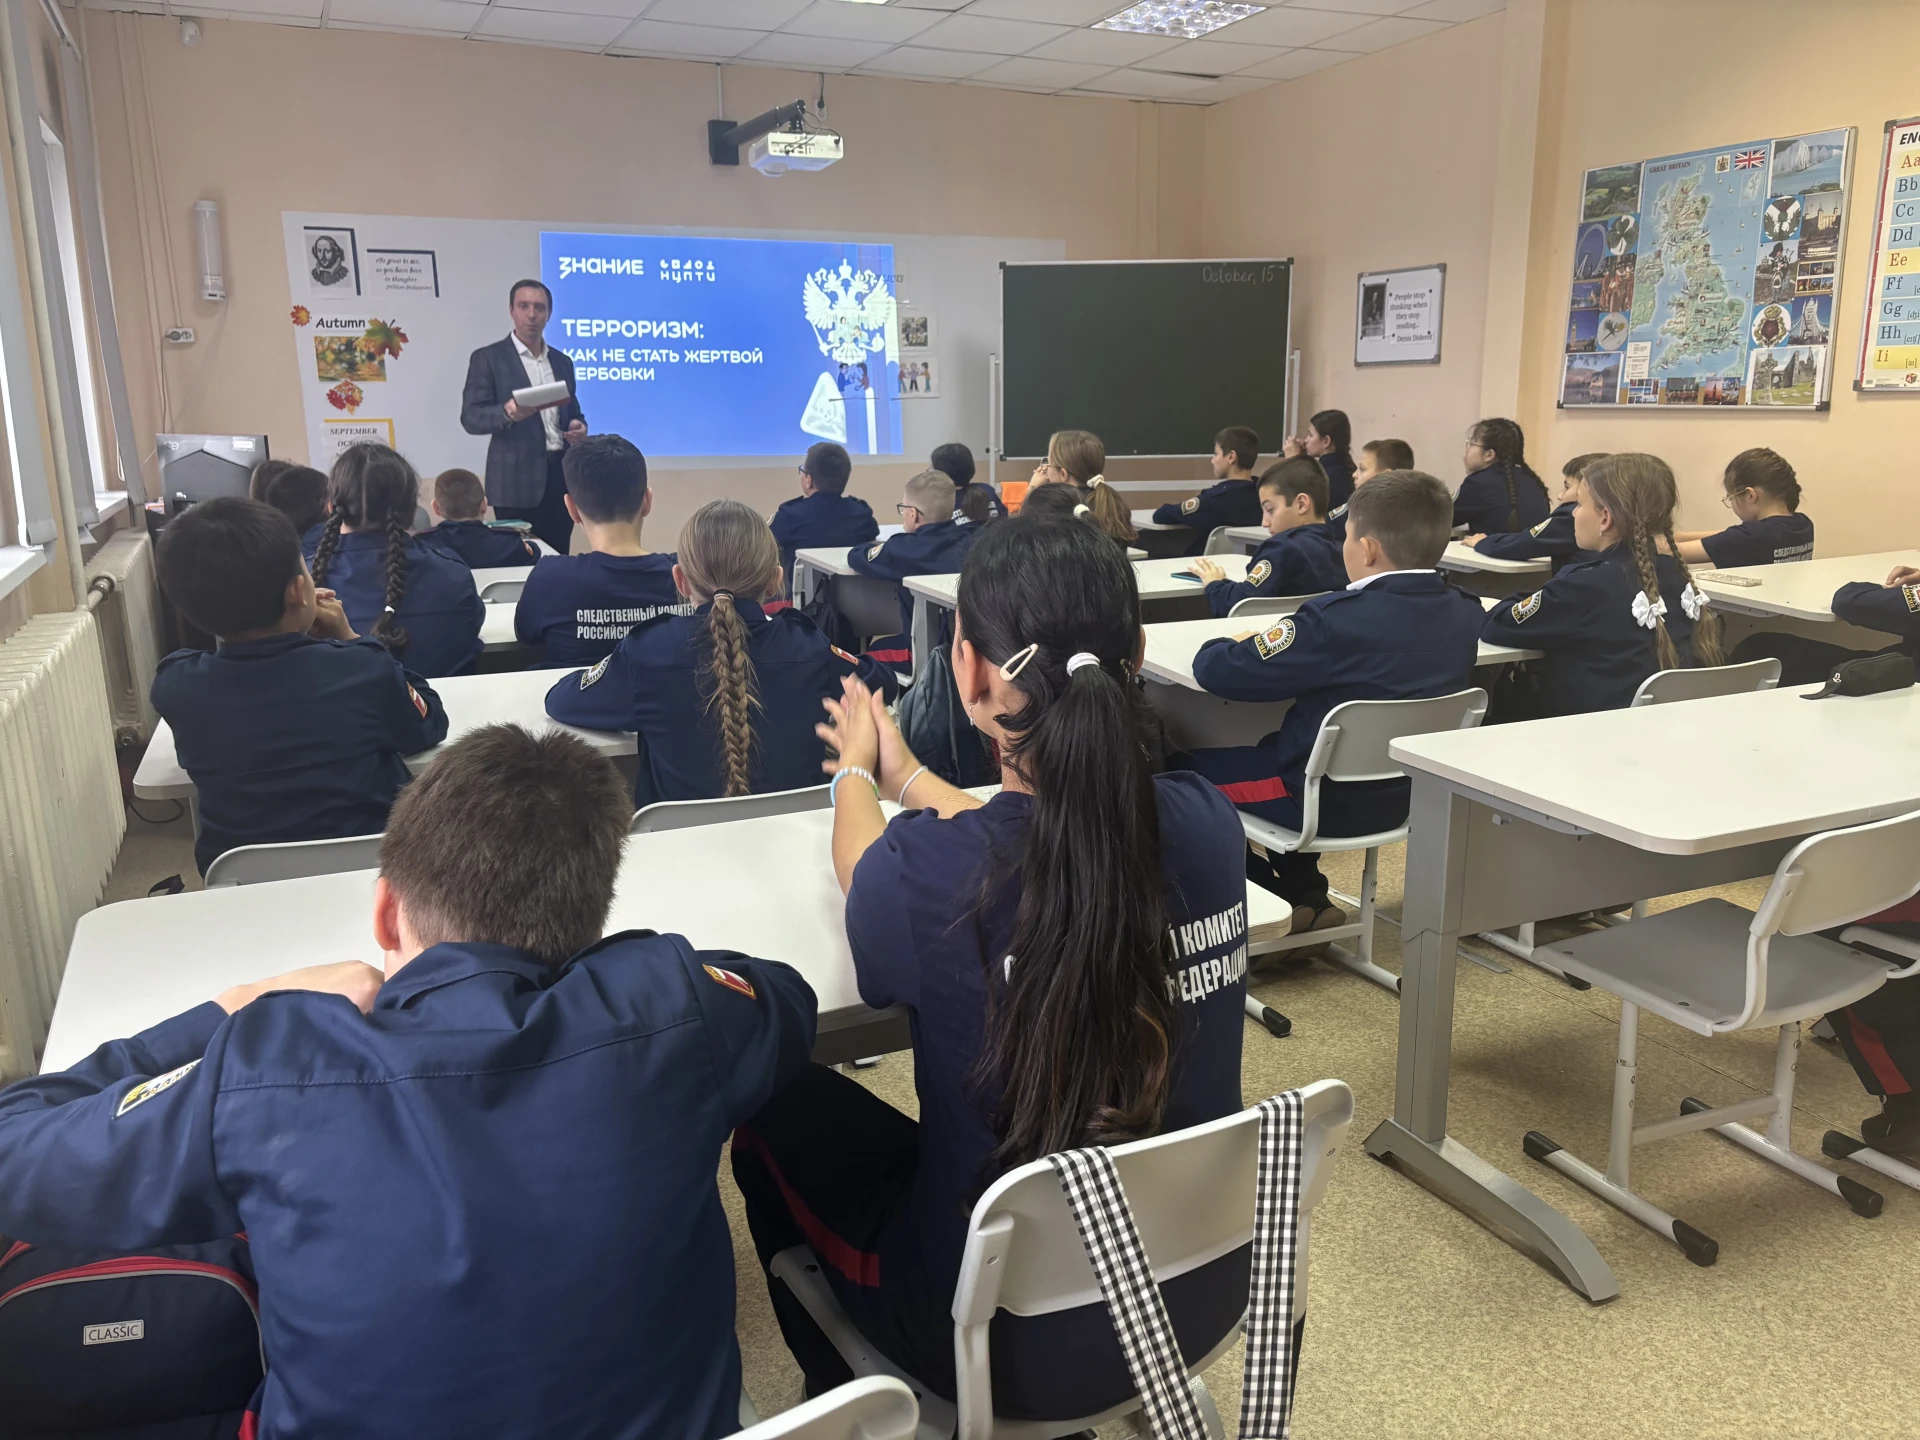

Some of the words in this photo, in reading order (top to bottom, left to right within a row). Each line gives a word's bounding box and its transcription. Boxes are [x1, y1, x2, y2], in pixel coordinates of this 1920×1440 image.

[1649, 165, 1667, 173] GREAT
[1668, 161, 1691, 170] BRITAIN
[1897, 177, 1918, 193] Bb
[1895, 203, 1914, 218] Cc
[1891, 227, 1913, 242] Dd
[1889, 253, 1908, 267] Ee
[1202, 265, 1257, 285] October,
[1261, 264, 1275, 283] 15
[1885, 276, 1904, 291] Ff
[1413, 292, 1426, 300] stop
[1408, 312, 1420, 320] stop
[1883, 301, 1903, 318] Gg
[315, 317, 366, 329] Autumn
[561, 319, 705, 339] ТЕРРОРИЗМ:
[1880, 325, 1902, 340] Hh
[602, 348, 626, 362] НЕ
[630, 349, 680, 363] СТАТЬ
[684, 347, 764, 364] ЖЕРТВОЙ
[575, 366, 655, 381] ЕРБОВКИ
[330, 427, 378, 435] SEPTEMBER
[576, 604, 656, 625] СЛЕДСТВЕННЫЙ
[1180, 901, 1245, 956] КОМИТЕТ
[88, 1325, 139, 1341] CLASSIC
